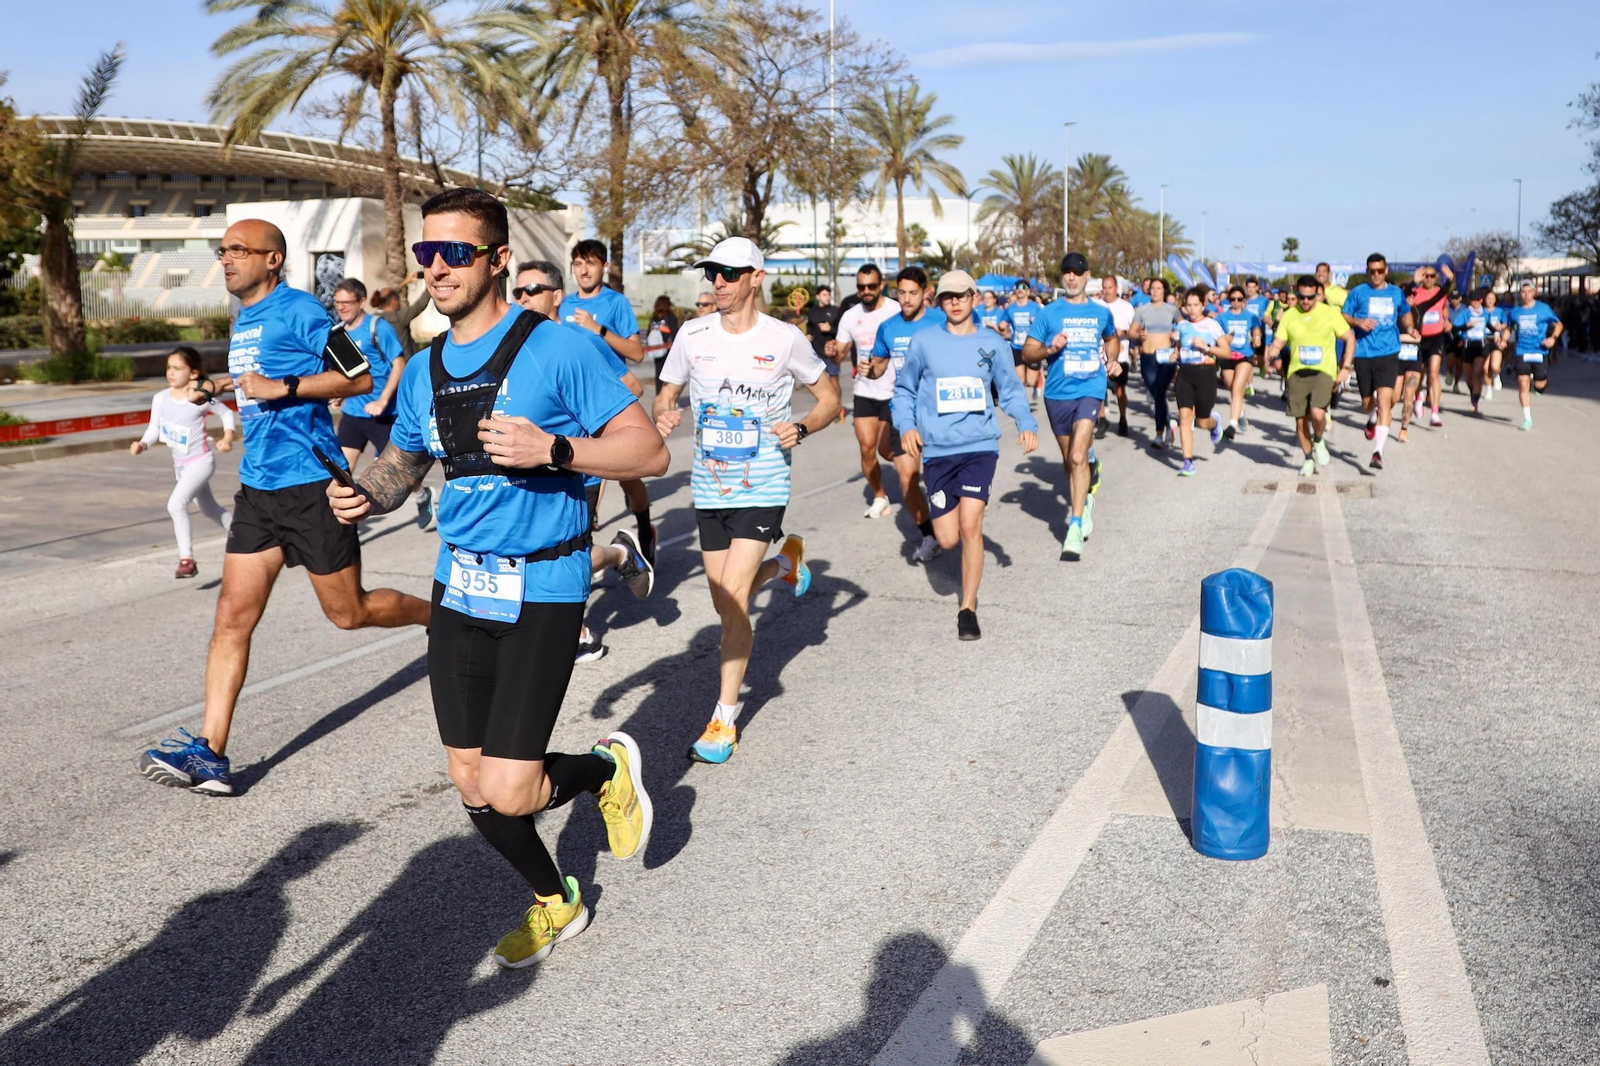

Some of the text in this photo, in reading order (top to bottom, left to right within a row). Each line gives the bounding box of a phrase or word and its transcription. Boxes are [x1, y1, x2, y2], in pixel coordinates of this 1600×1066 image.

[1063, 317, 1098, 326] mayoral
[947, 387, 976, 400] 2811
[716, 431, 743, 445] 380
[461, 570, 498, 593] 955
